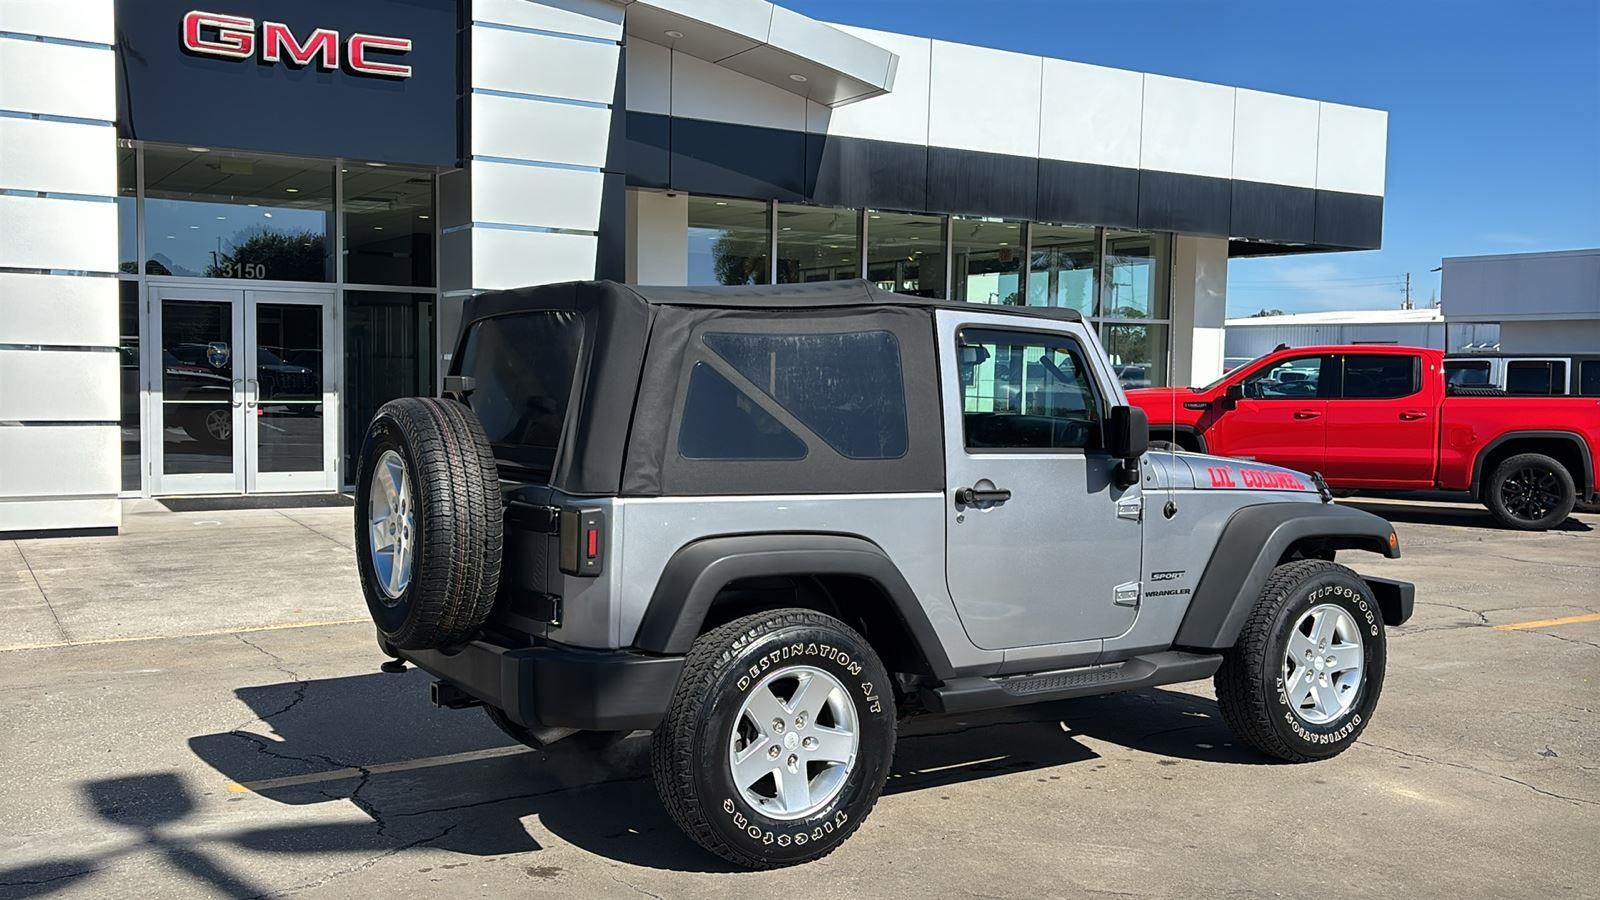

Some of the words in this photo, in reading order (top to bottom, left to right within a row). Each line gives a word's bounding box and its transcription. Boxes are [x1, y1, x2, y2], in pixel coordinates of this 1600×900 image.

[183, 10, 412, 78] GMC
[222, 262, 266, 279] 3150
[1239, 468, 1306, 490] COLONEL
[1152, 571, 1185, 581] SPORT
[1145, 588, 1191, 597] WRANGLER
[736, 643, 862, 691] DESTINATION
[861, 680, 882, 714] A/T
[1284, 711, 1362, 745] DESTINATION
